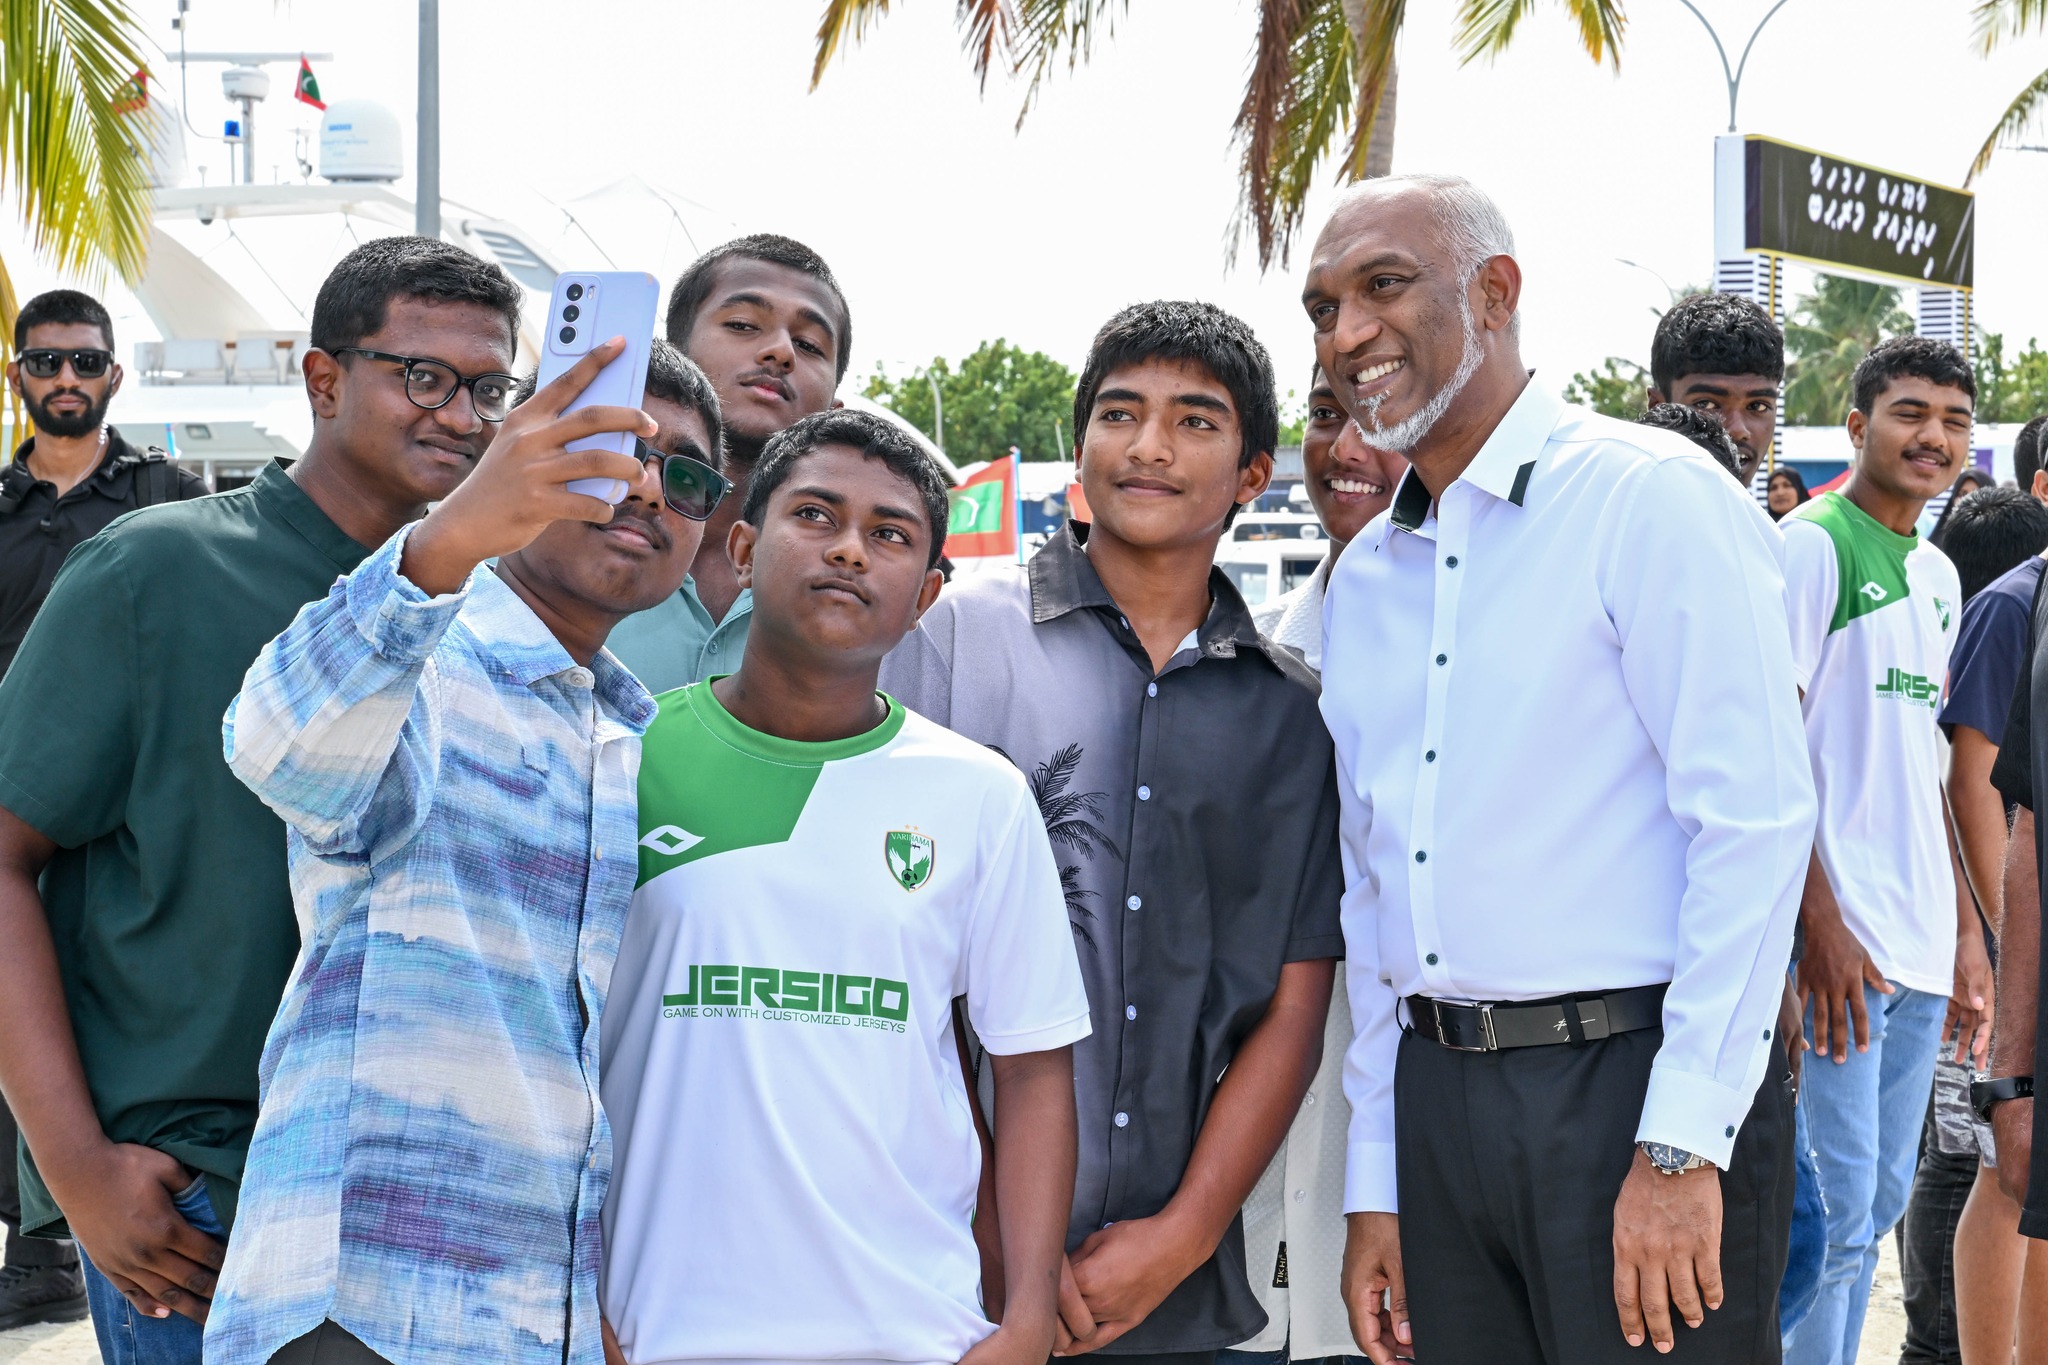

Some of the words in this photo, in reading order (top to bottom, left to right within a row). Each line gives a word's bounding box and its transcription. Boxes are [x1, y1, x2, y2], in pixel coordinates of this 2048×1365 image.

[663, 965, 909, 1022] JERSIGO
[663, 1008, 699, 1019] GAME
[702, 1007, 723, 1018] ON
[726, 1007, 759, 1020] WITH
[762, 1009, 851, 1027] CUSTOMIZED
[854, 1017, 906, 1034] JERSEYS
